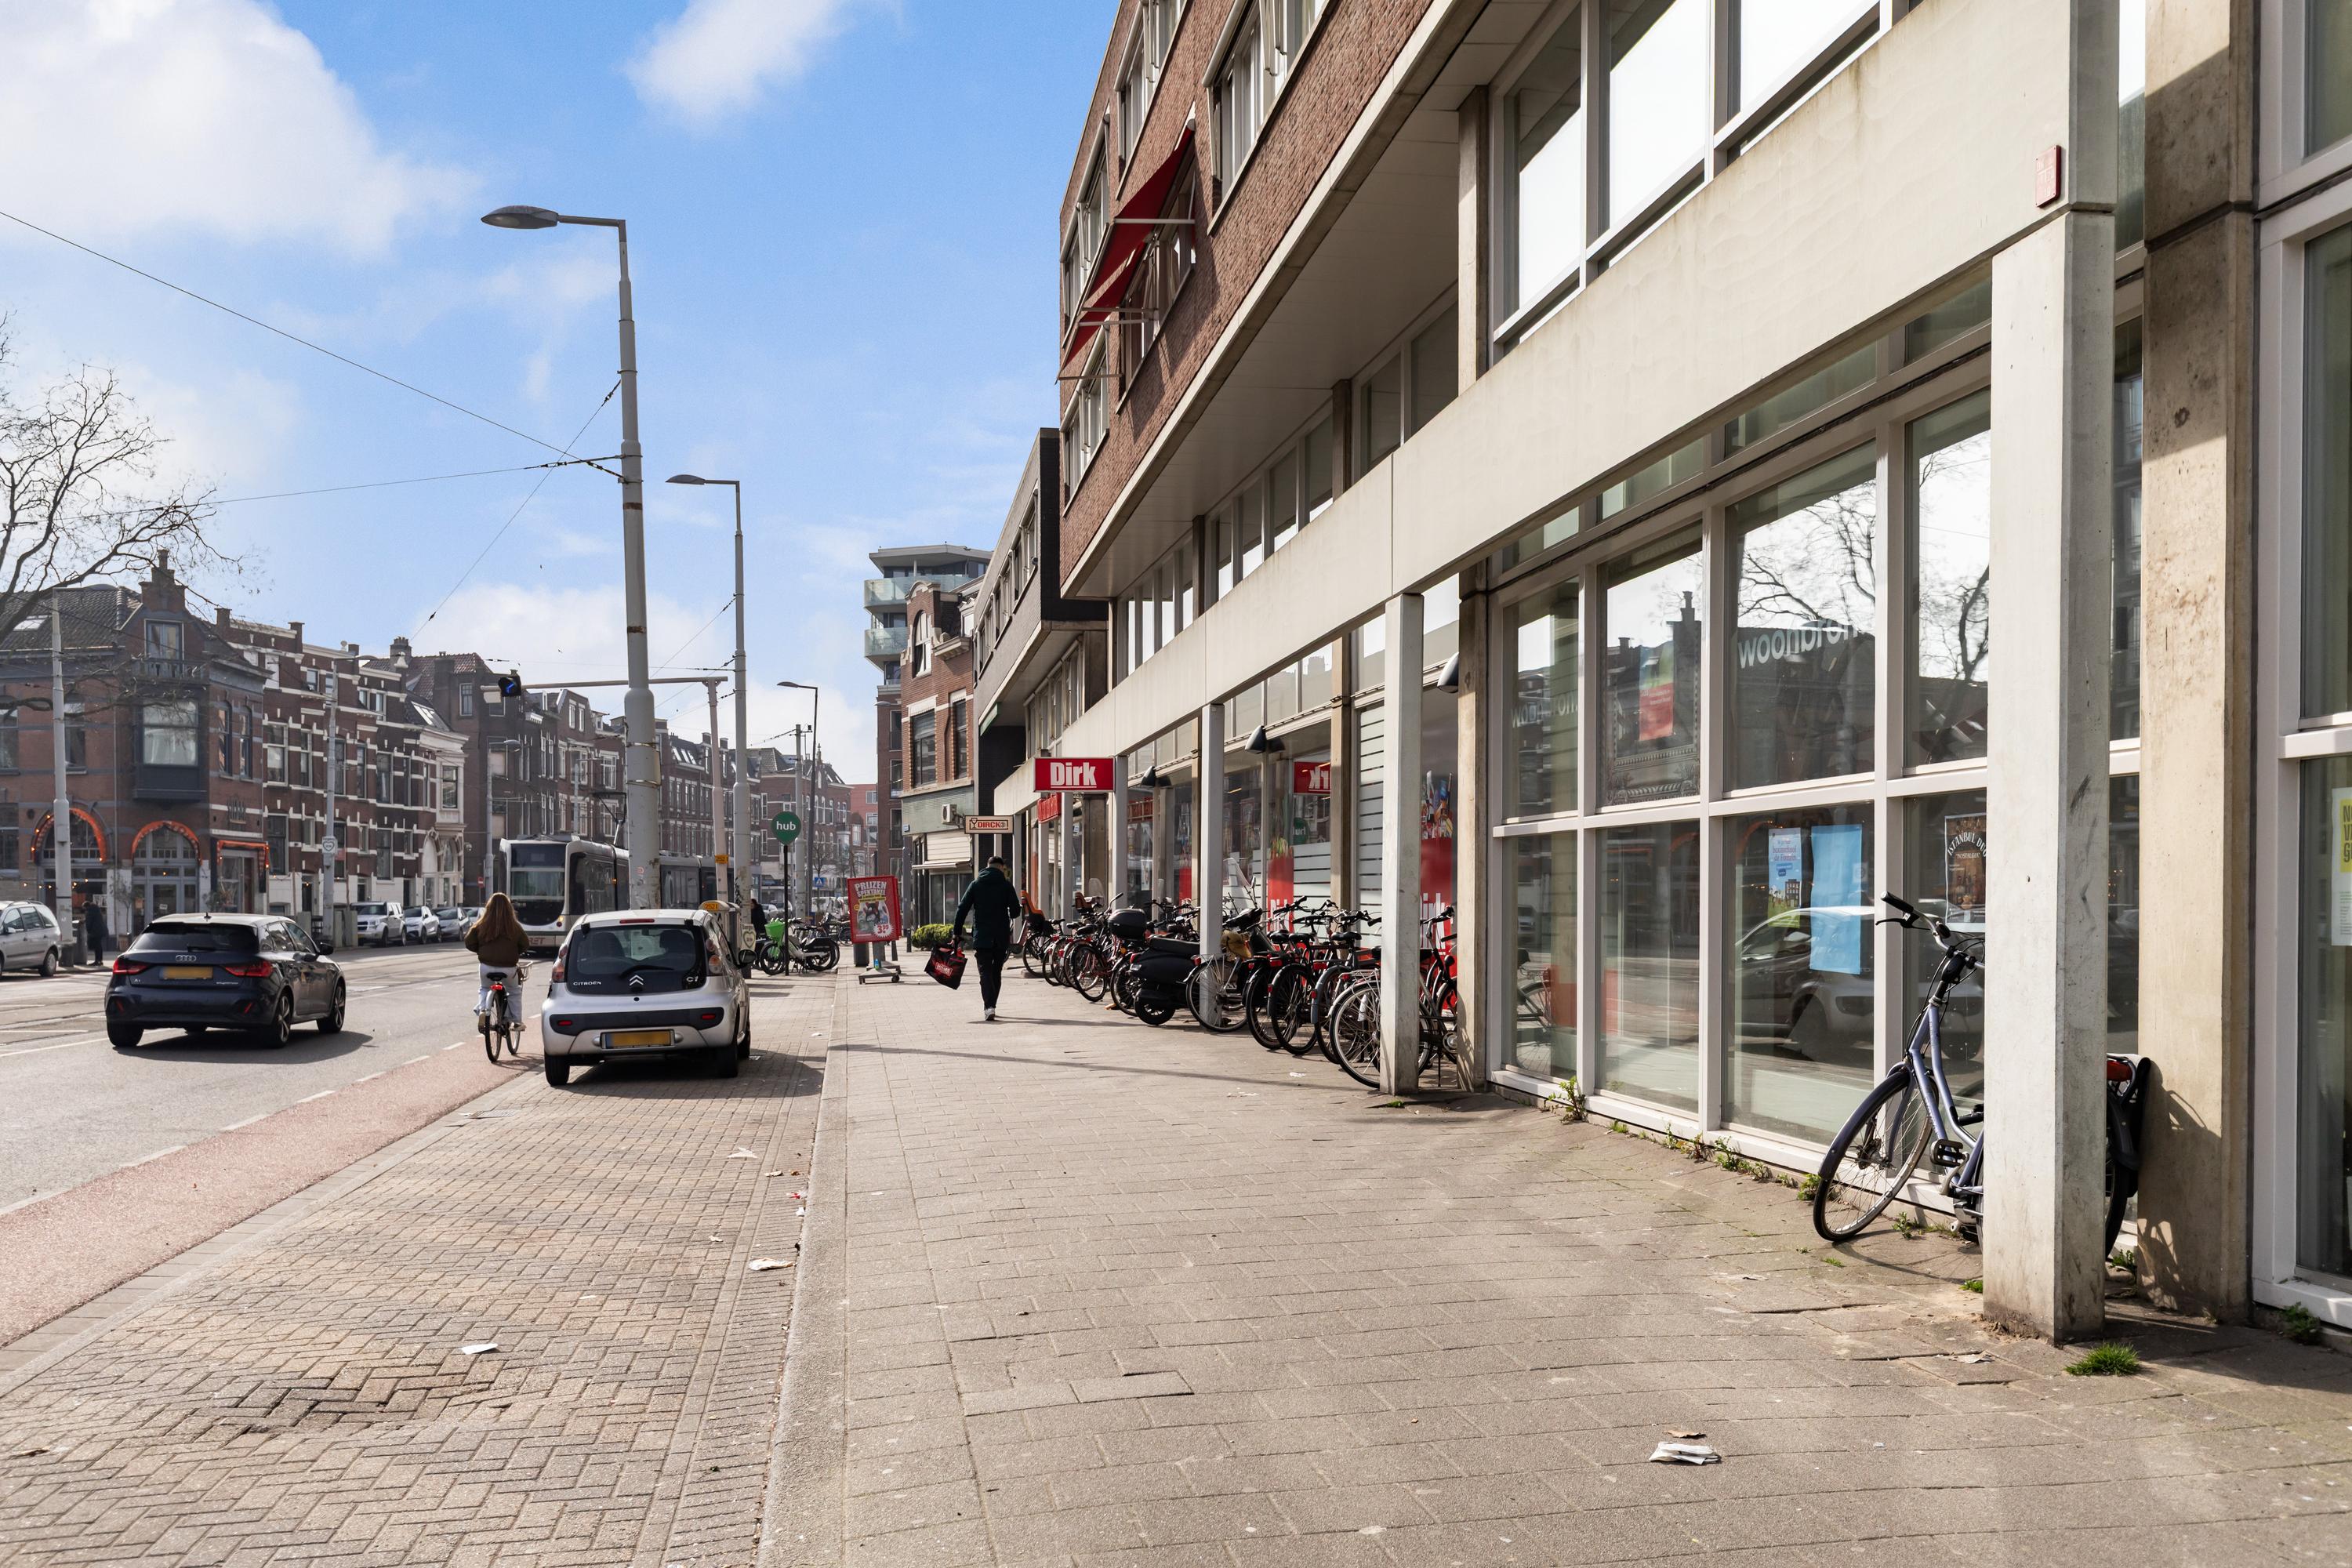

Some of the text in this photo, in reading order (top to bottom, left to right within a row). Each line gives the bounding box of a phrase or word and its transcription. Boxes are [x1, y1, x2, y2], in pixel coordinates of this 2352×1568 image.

[1050, 762, 1097, 786] Dirk
[776, 821, 797, 830] hub
[1947, 832, 1975, 856] ISTANBUL
